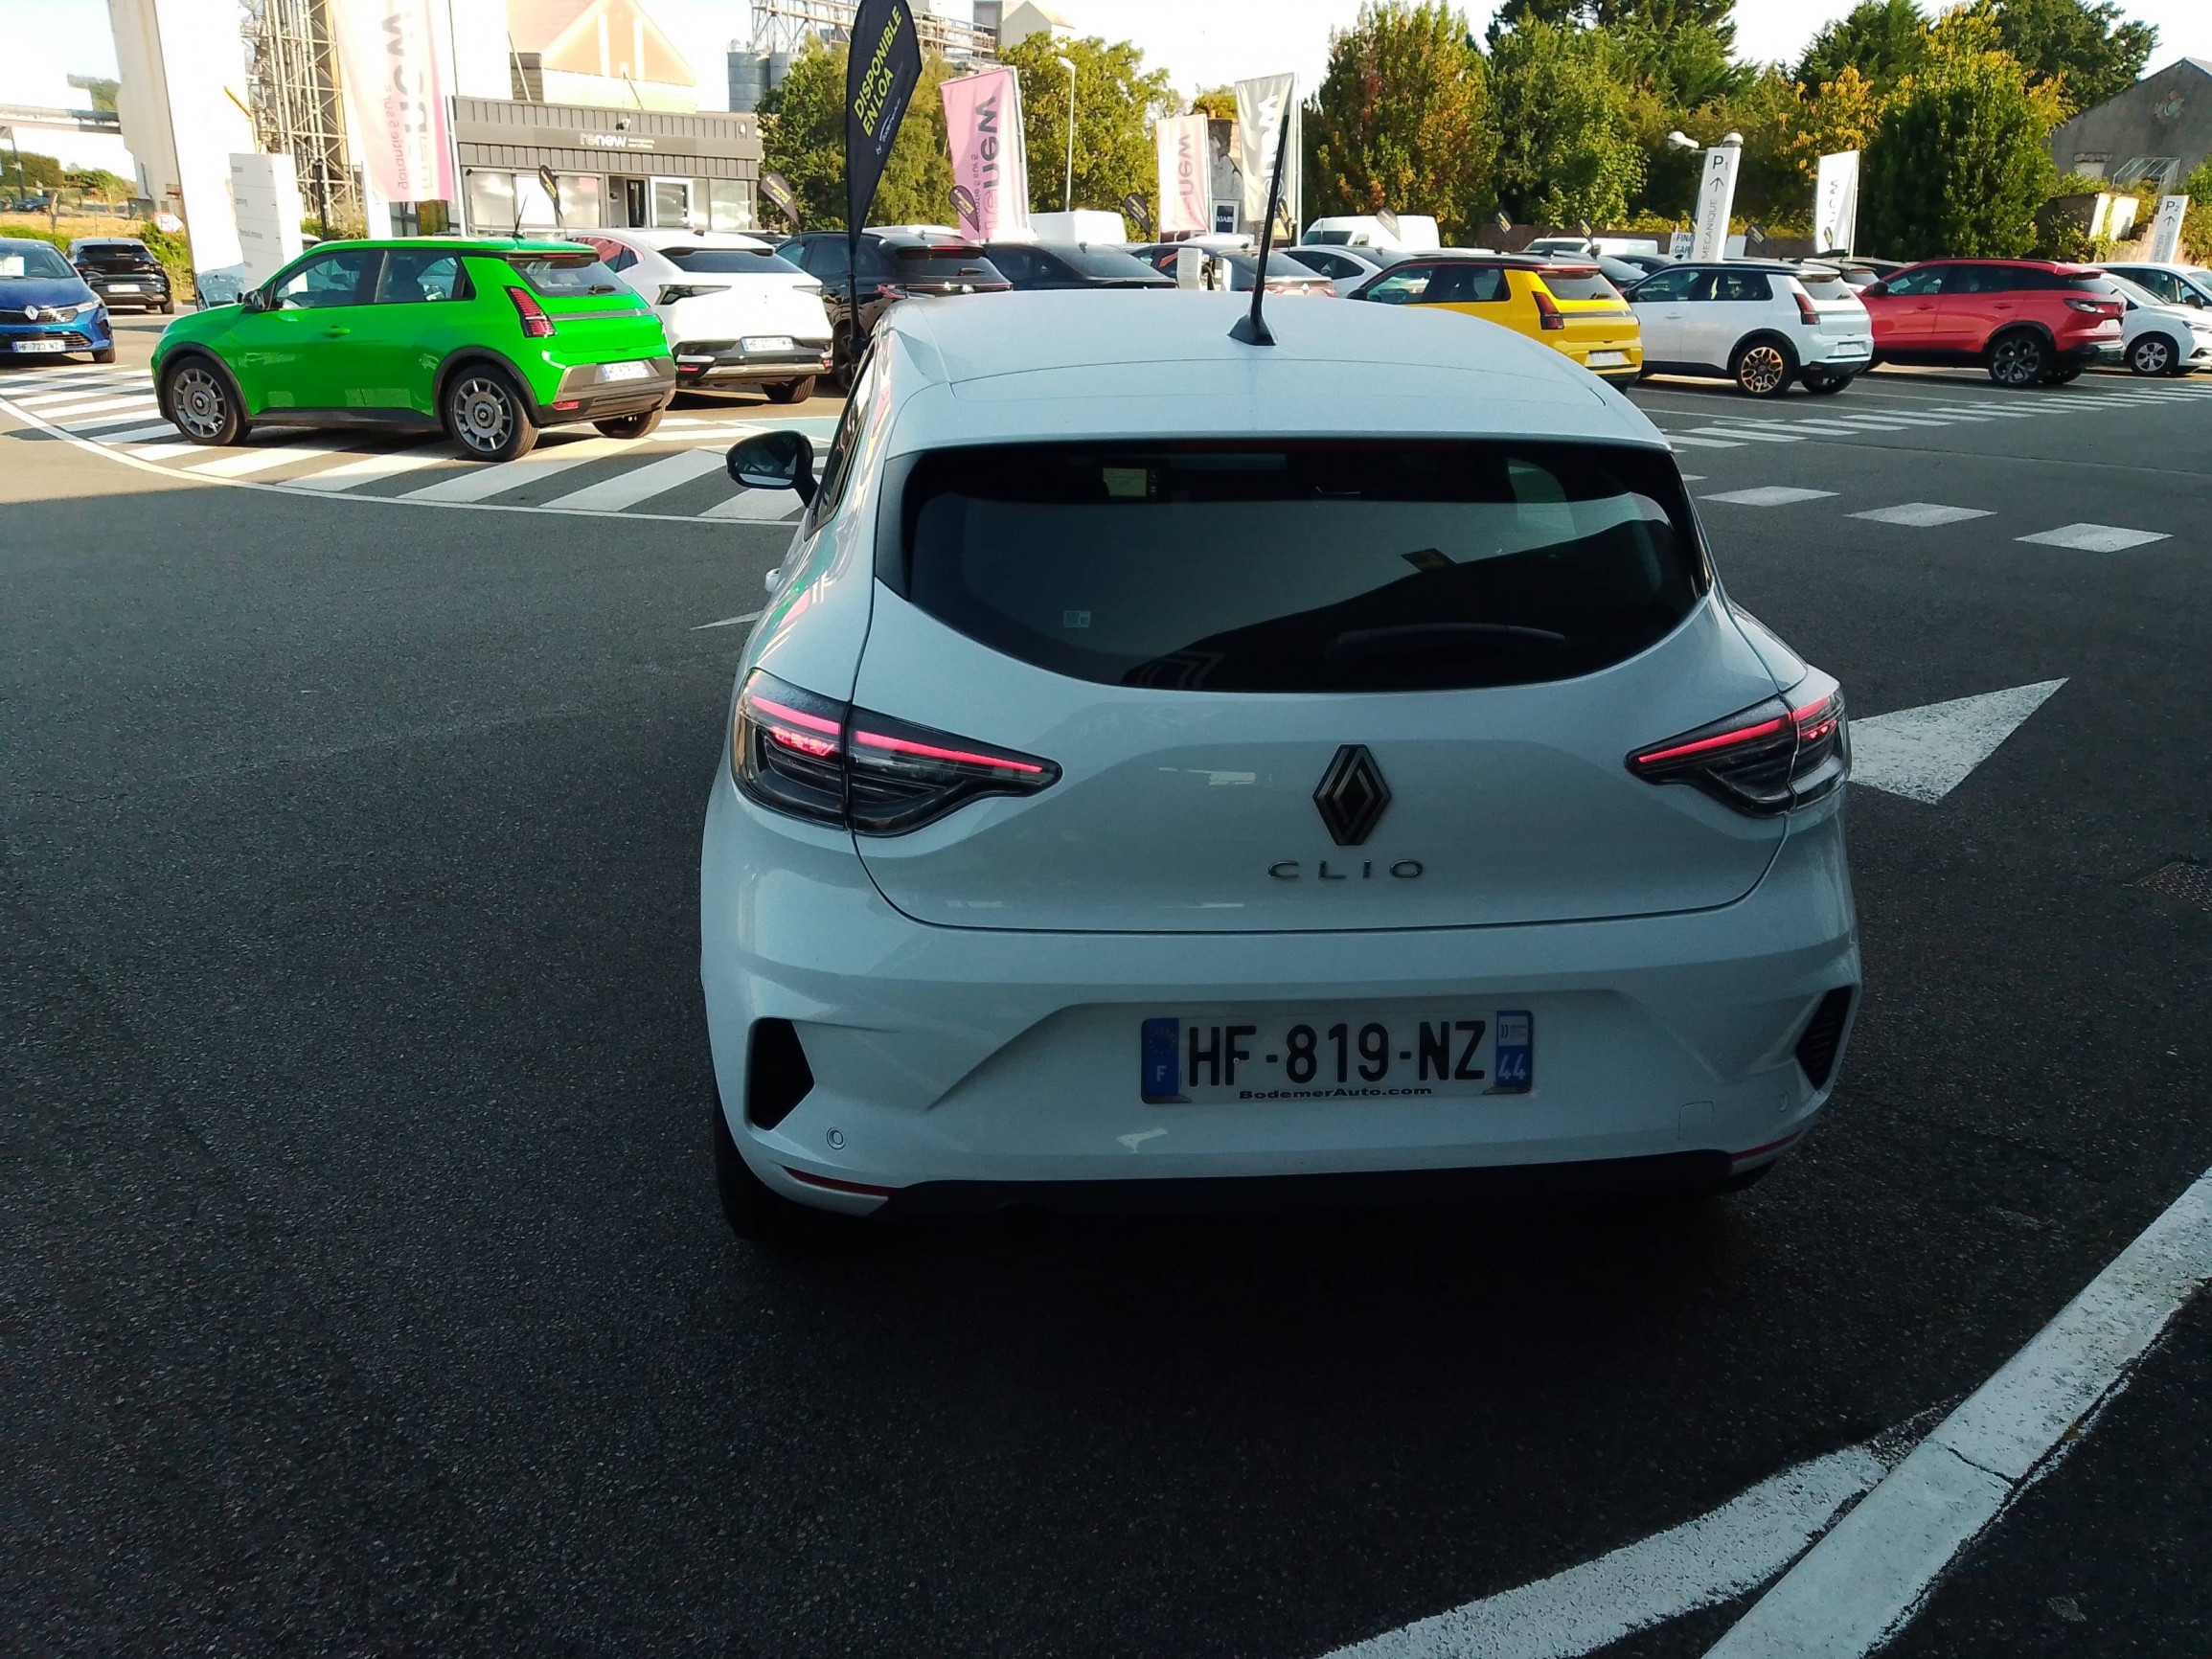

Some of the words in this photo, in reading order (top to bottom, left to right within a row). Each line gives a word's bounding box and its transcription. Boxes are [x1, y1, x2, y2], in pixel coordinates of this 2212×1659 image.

[854, 5, 902, 121] DISPONIBLE
[862, 102, 878, 137] EN
[874, 66, 894, 110] LOA
[1701, 198, 1717, 259] MECANIQUE
[1267, 859, 1423, 880] CLIO
[1156, 1064, 1167, 1081] F
[1189, 1020, 1487, 1086] HF-819-NZ
[1497, 1054, 1526, 1080] 44
[1239, 1087, 1432, 1100] BodemerAuto.com
